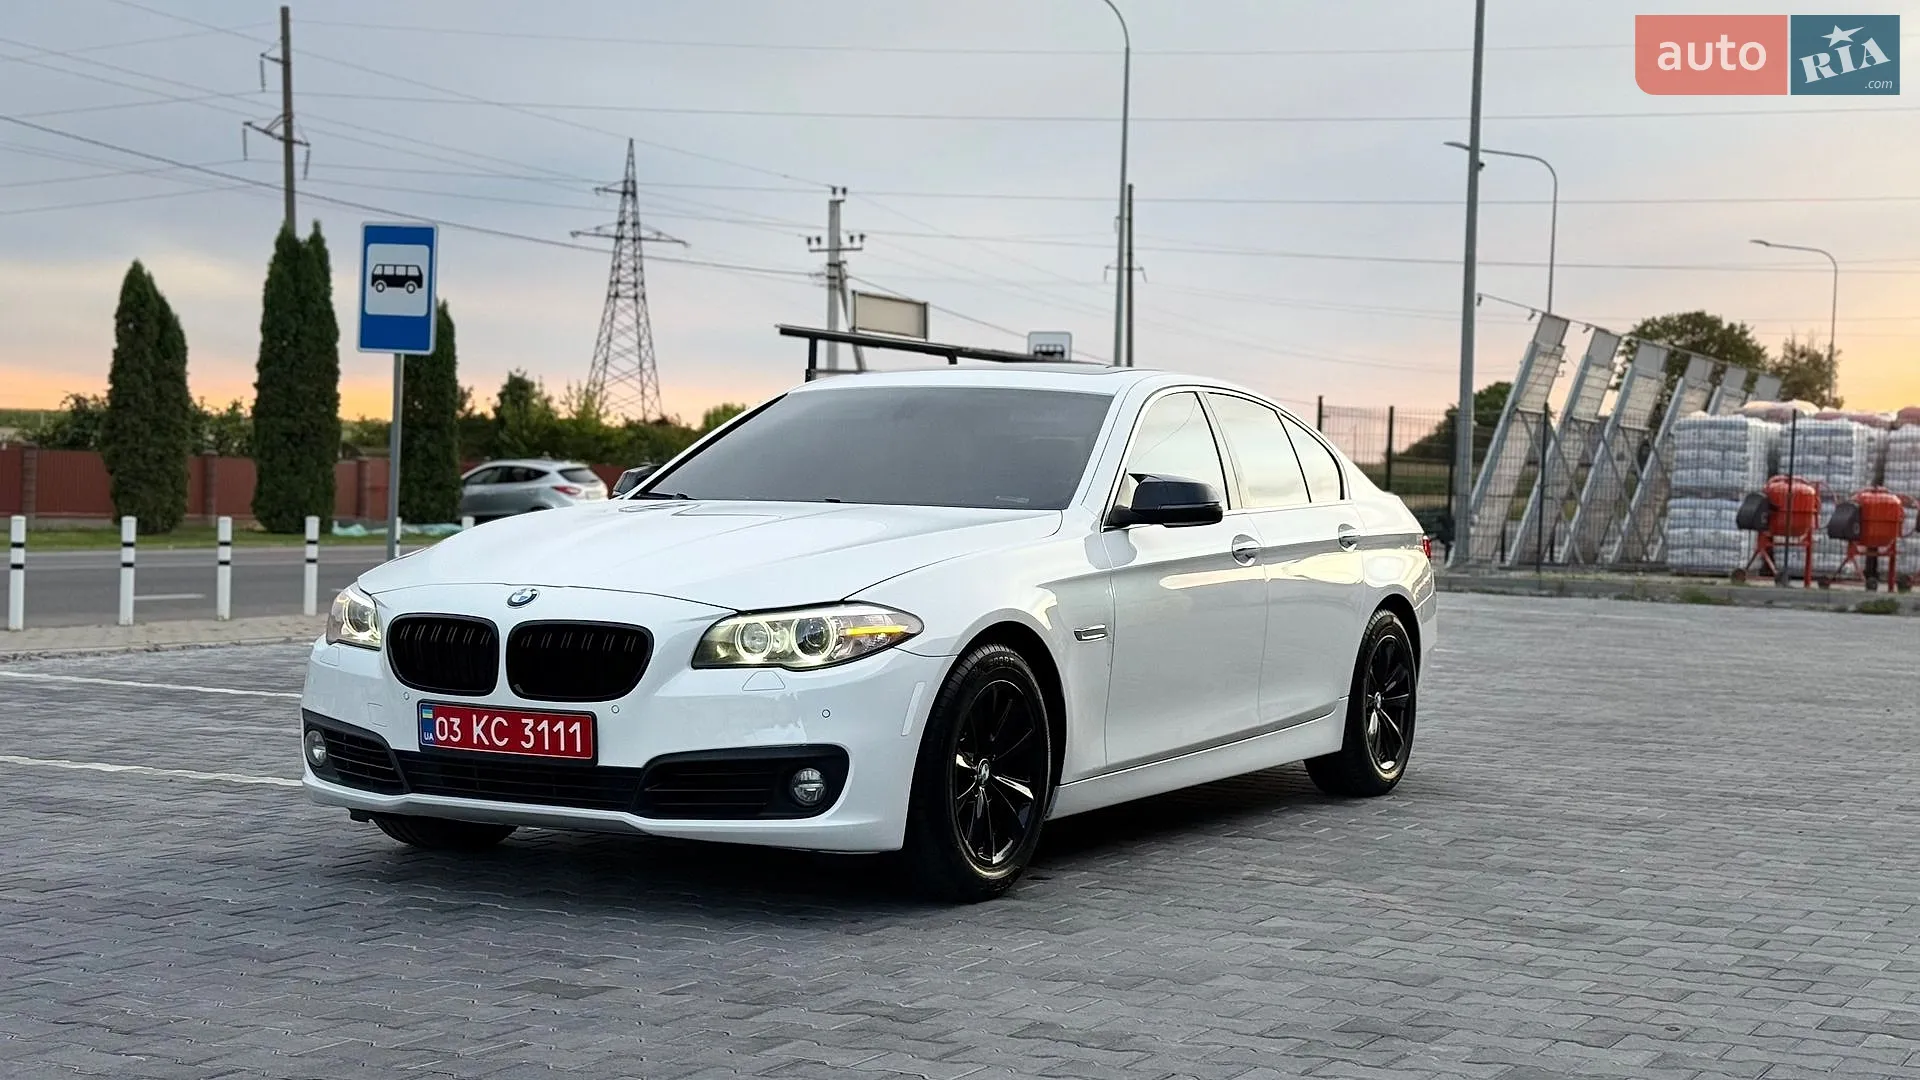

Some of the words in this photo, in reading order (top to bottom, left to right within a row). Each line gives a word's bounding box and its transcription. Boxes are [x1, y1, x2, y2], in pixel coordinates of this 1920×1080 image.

[423, 732, 435, 741] UA
[435, 716, 461, 742] 03
[472, 714, 509, 746] KC
[520, 718, 581, 752] 3111
